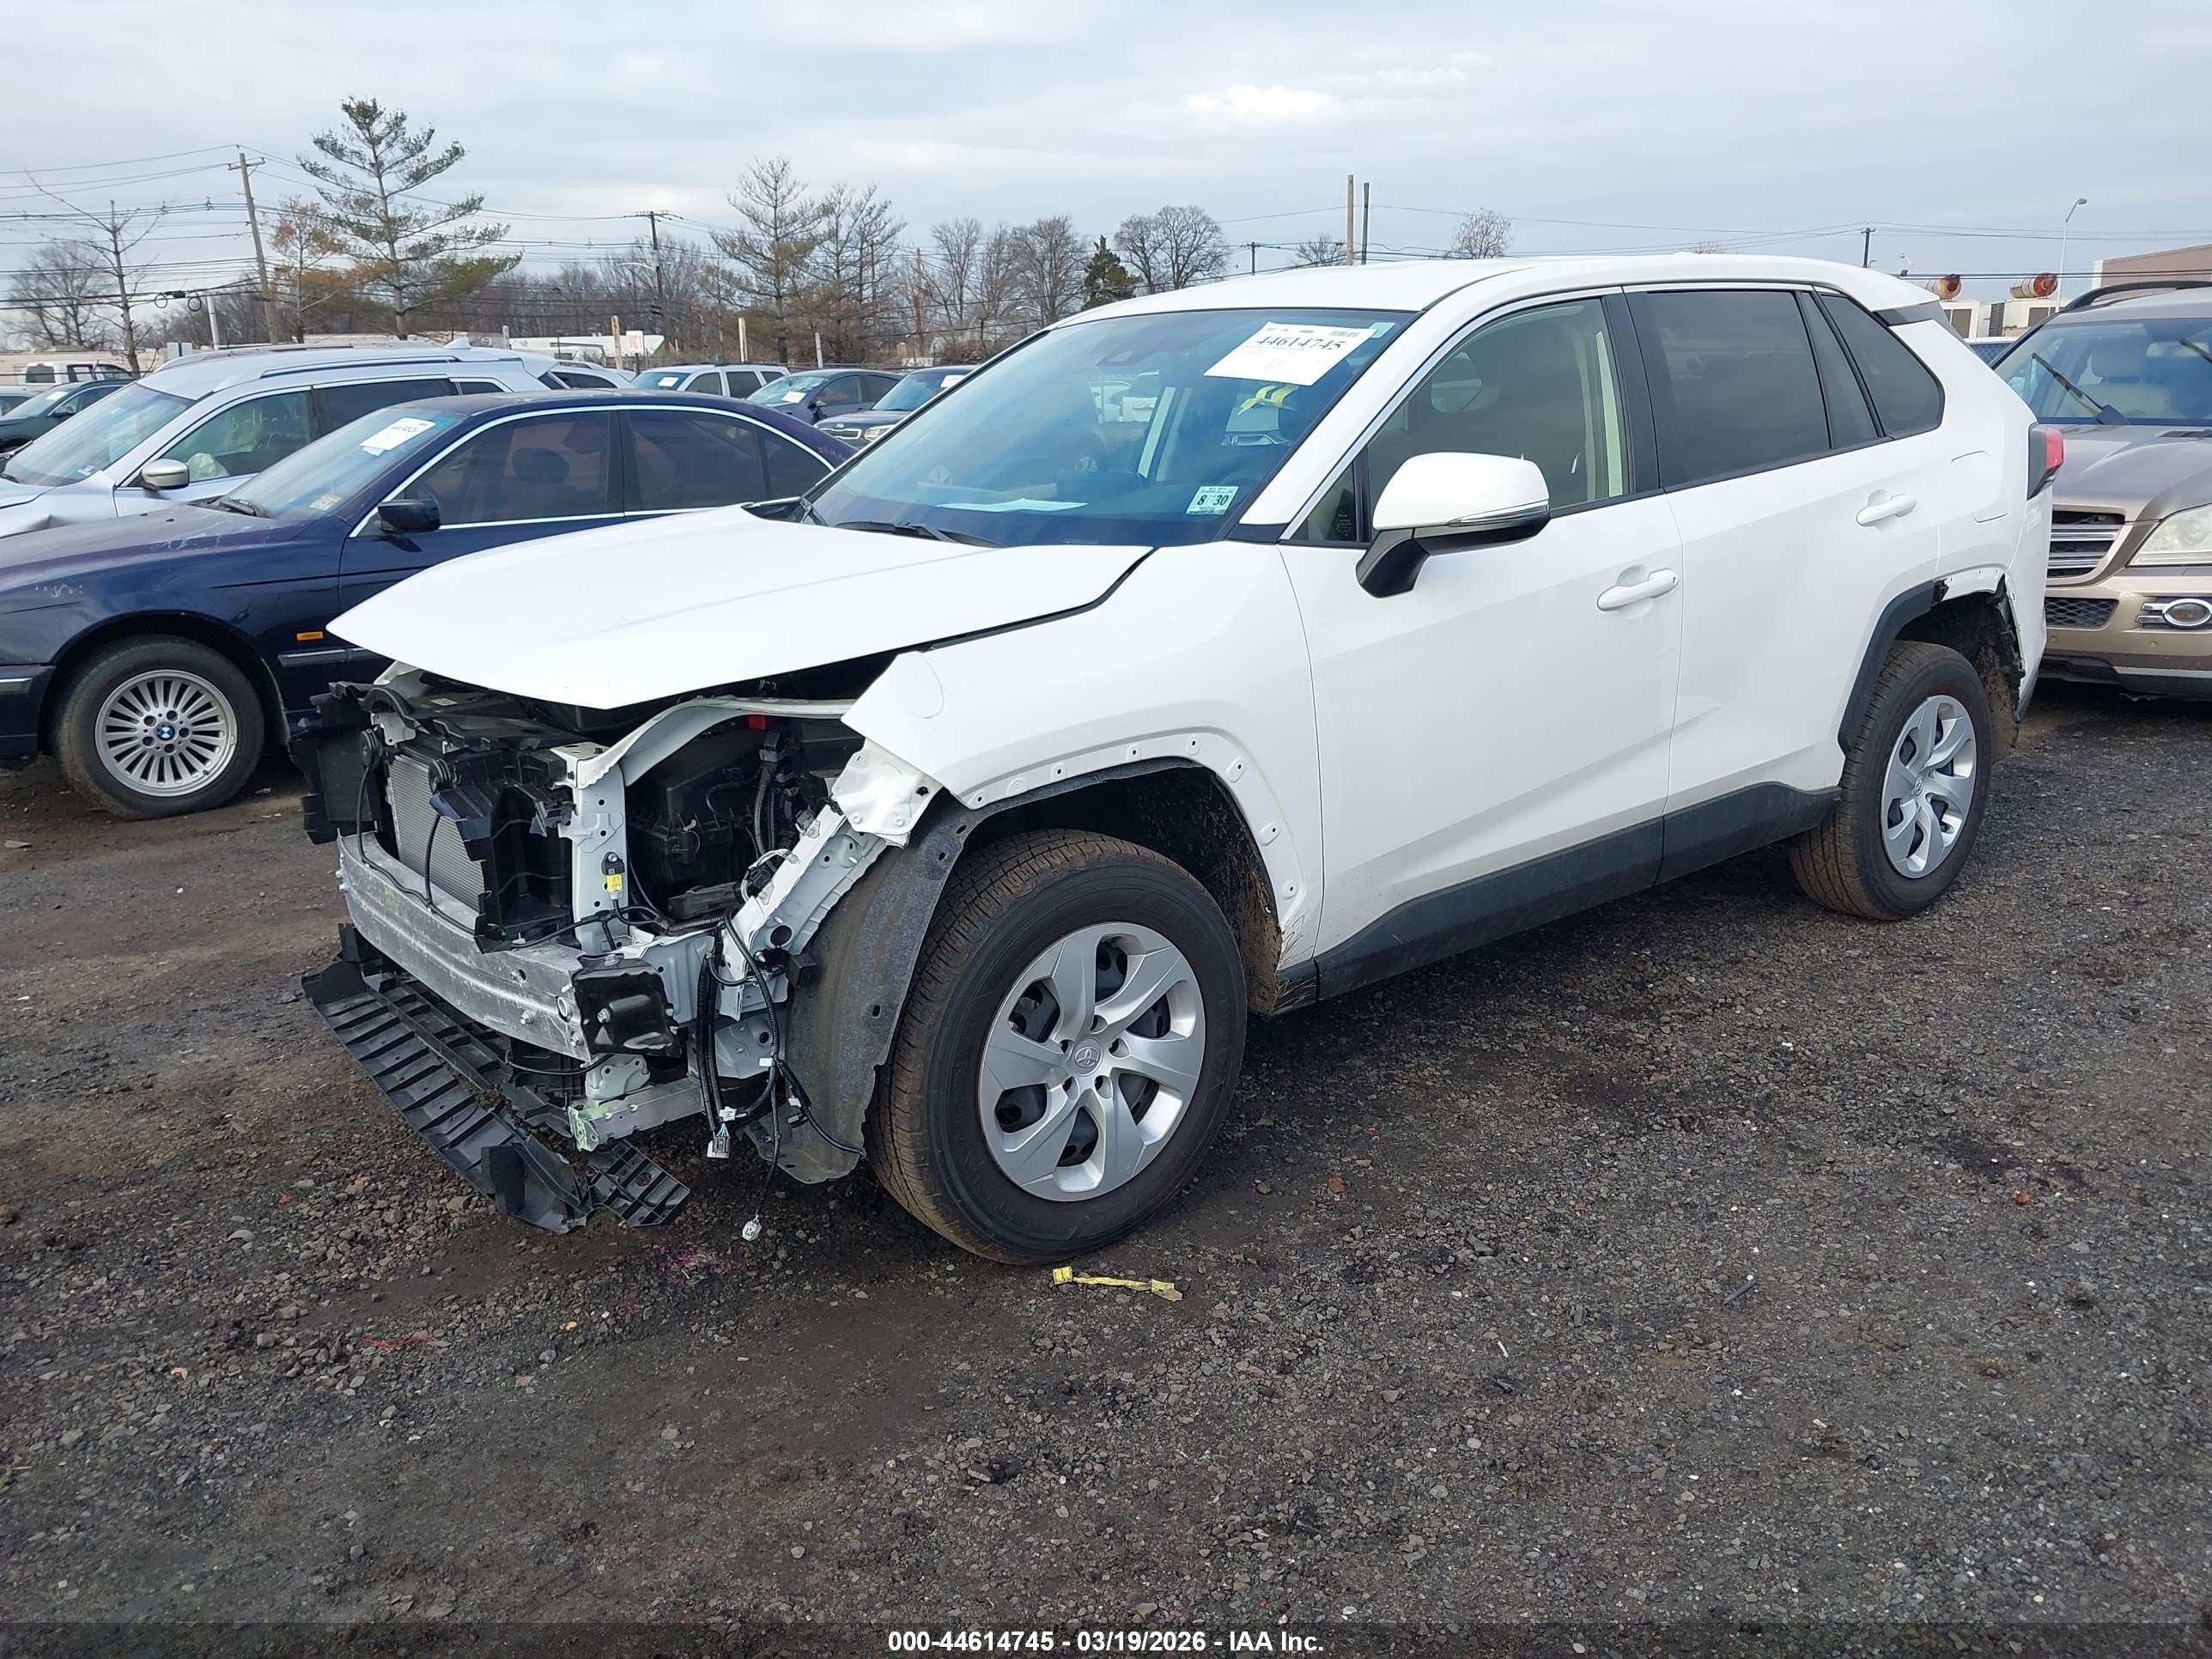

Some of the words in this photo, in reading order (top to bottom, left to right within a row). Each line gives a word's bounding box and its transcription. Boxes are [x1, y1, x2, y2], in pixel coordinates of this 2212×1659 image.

[1256, 336, 1346, 350] 44614745
[1197, 495, 1207, 506] 8
[1212, 495, 1229, 506] 30
